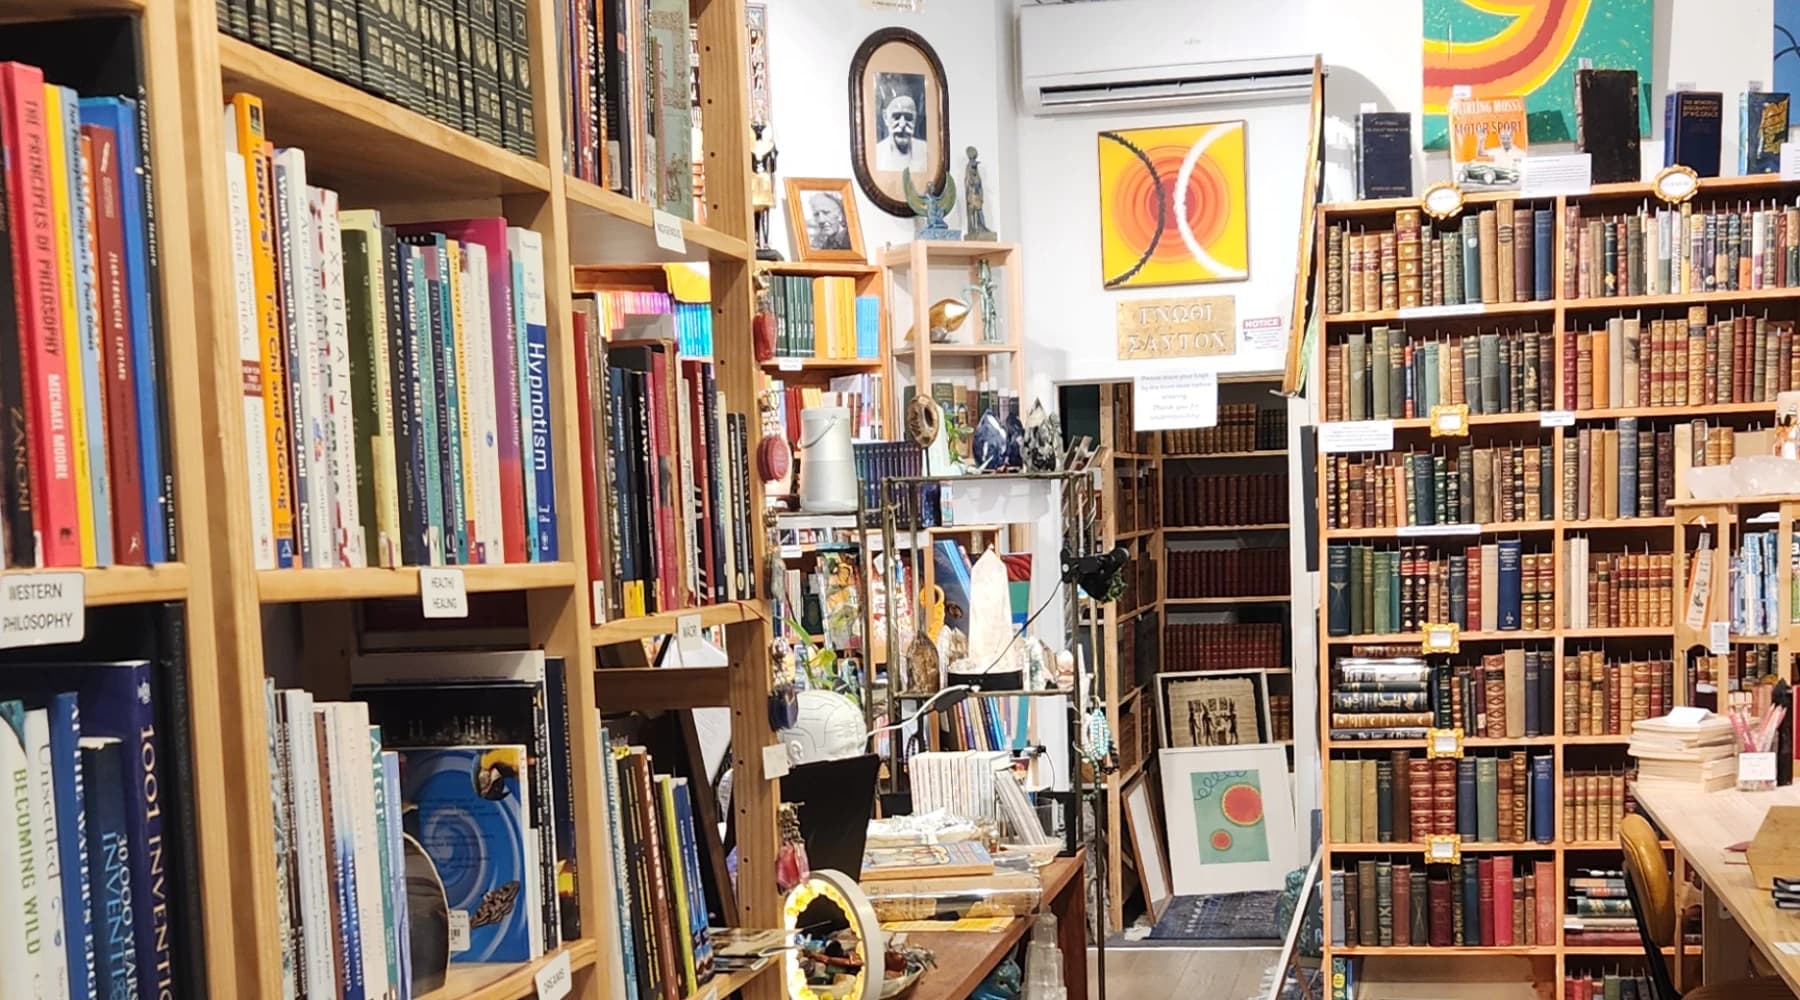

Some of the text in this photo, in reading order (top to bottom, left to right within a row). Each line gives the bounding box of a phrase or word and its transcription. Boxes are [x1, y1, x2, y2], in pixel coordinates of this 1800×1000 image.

[139, 100, 150, 152] Treatise
[1454, 120, 1522, 136] MOTOR SPORT
[144, 173, 154, 218] Human
[277, 174, 288, 227] What's
[24, 100, 60, 357] THE PRINCIPLES OF PHILOSOPHY
[148, 222, 157, 266] Nature
[231, 181, 251, 345] CLEANSE TO HEAL
[281, 231, 292, 282] Wrong
[406, 257, 414, 283] THE
[438, 247, 447, 284] HELP
[392, 279, 401, 322] SLEEP
[1245, 318, 1279, 328] NOTICE
[269, 337, 279, 373] Chi
[410, 335, 420, 378] NERVE
[272, 380, 282, 418] and
[396, 328, 408, 436] REVOLUTION
[414, 382, 422, 423] RESET
[528, 342, 548, 470] Hypnotism
[47, 374, 68, 479] MICHAEL MOORE
[292, 382, 305, 442] Dorothy
[10, 407, 30, 511] ZANONI
[275, 426, 288, 509] QiGong
[297, 445, 306, 477] Hall
[165, 475, 176, 555] David Hume
[8, 583, 62, 600] WESTERN
[3, 612, 72, 632] PHILOSOPHY
[73, 749, 86, 801] THE
[140, 724, 161, 824] 1001
[370, 735, 385, 819] After
[13, 768, 37, 889] BECOMING
[38, 743, 60, 881] Unsettled
[22, 896, 41, 955] WILD
